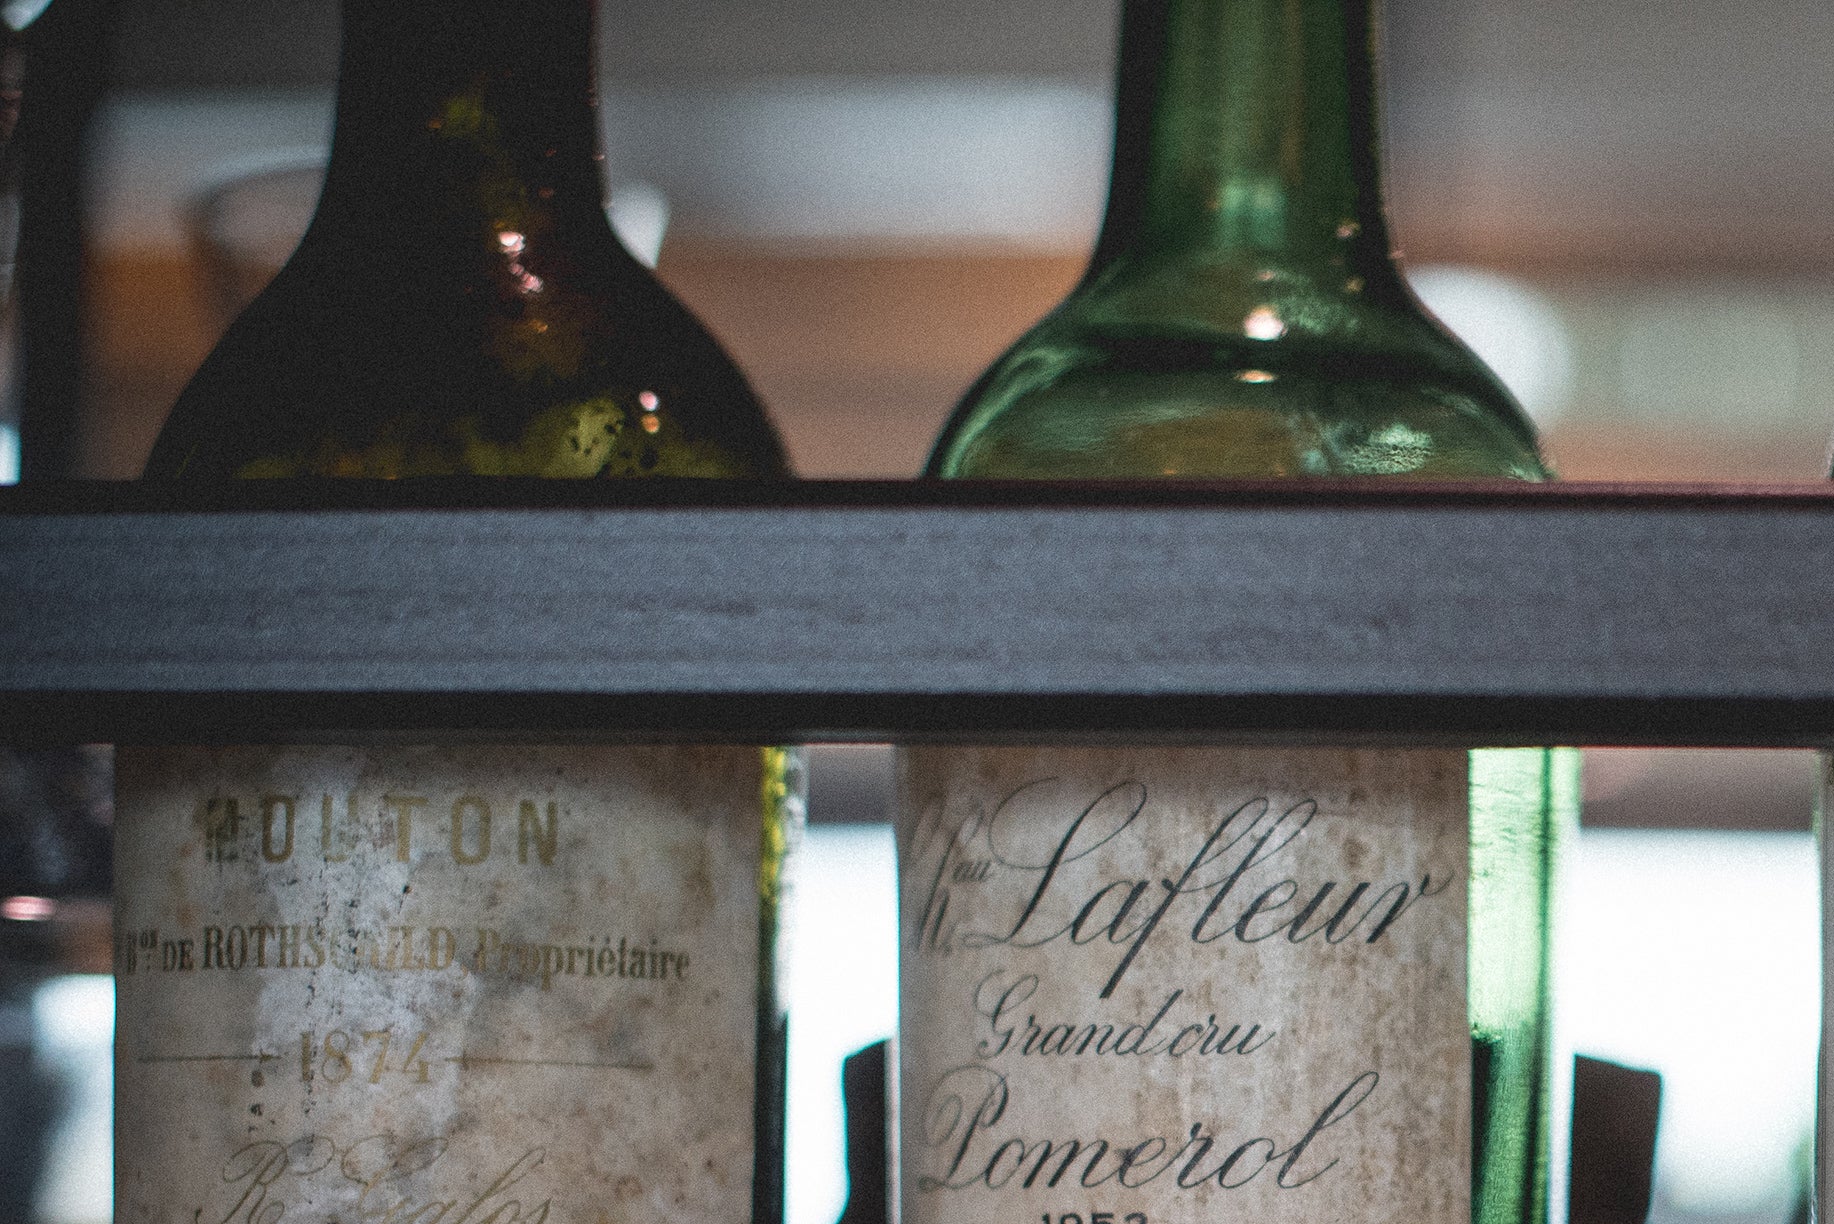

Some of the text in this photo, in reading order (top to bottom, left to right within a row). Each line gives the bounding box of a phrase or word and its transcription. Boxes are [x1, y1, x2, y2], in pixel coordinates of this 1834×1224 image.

[961, 776, 1457, 999] Lafleur
[298, 1029, 434, 1086] 1874
[972, 969, 1185, 1059] Grand
[917, 1063, 1381, 1191] Pomerol
